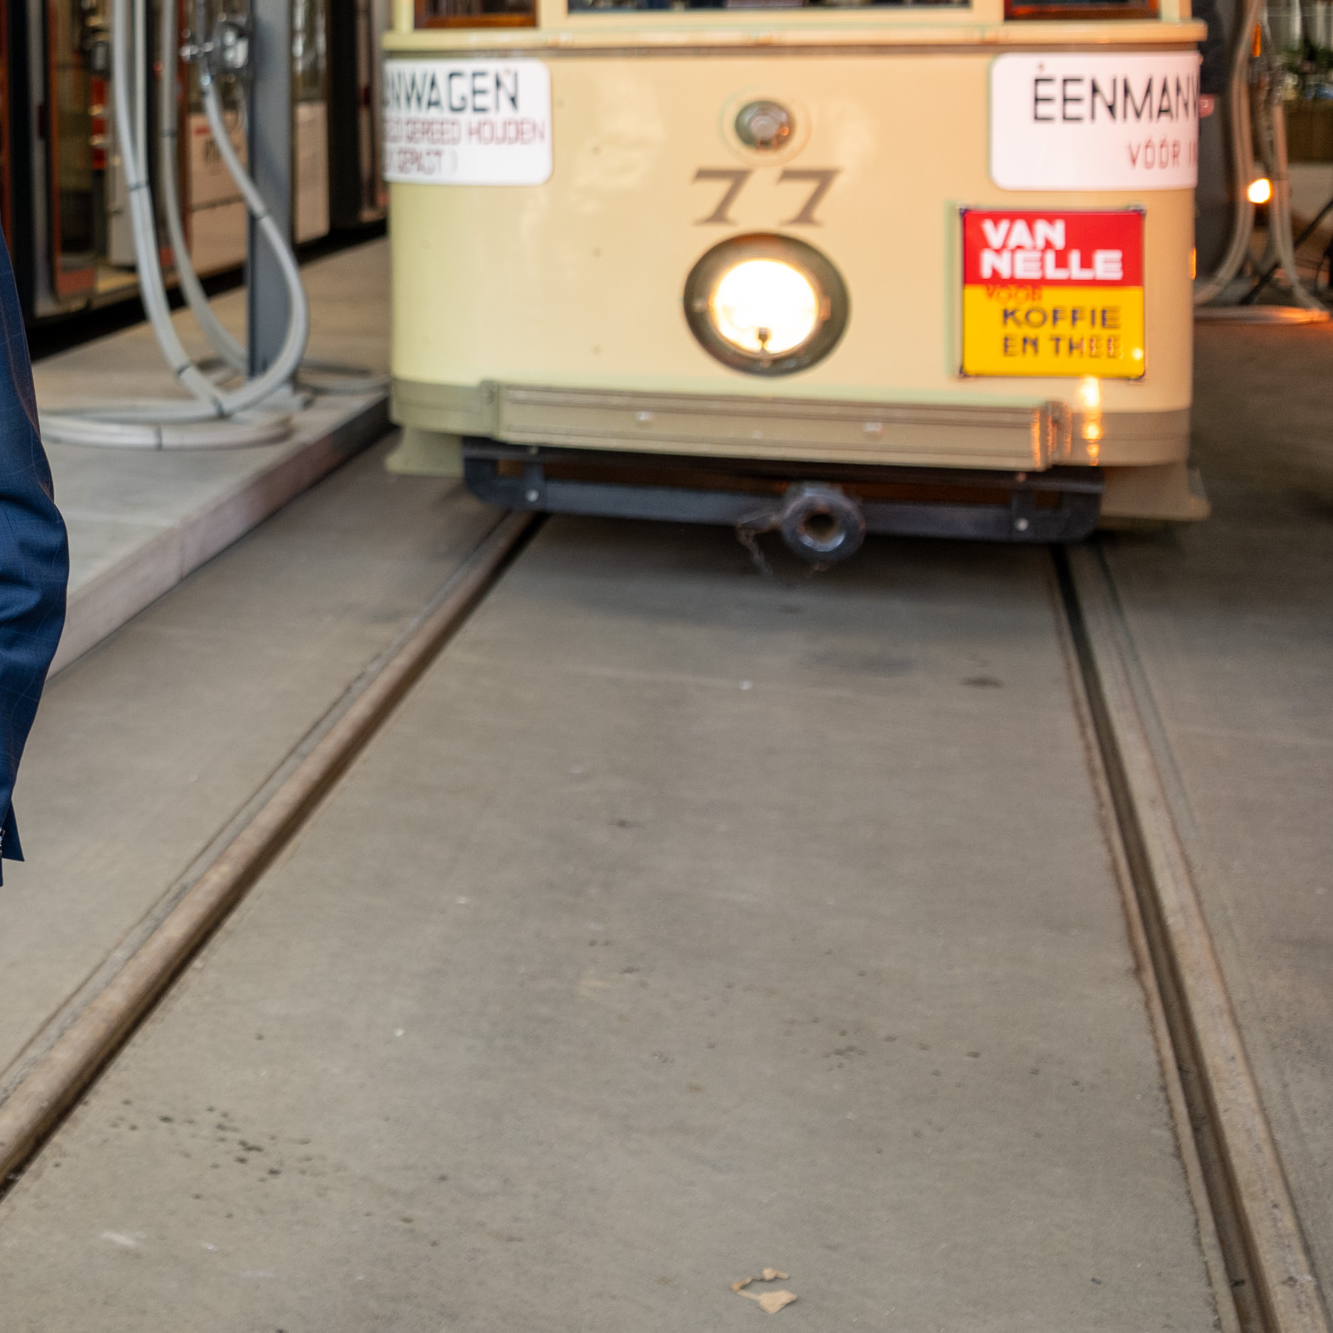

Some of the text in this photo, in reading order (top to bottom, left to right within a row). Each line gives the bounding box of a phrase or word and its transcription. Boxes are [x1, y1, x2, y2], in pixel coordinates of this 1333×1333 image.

[382, 70, 519, 112] NWAGEN
[690, 168, 845, 227] 77
[981, 218, 1066, 251] VAN
[979, 248, 1124, 281] NELLE
[1001, 306, 1122, 330] KOFFIE
[1002, 334, 1122, 359] EN THEE
